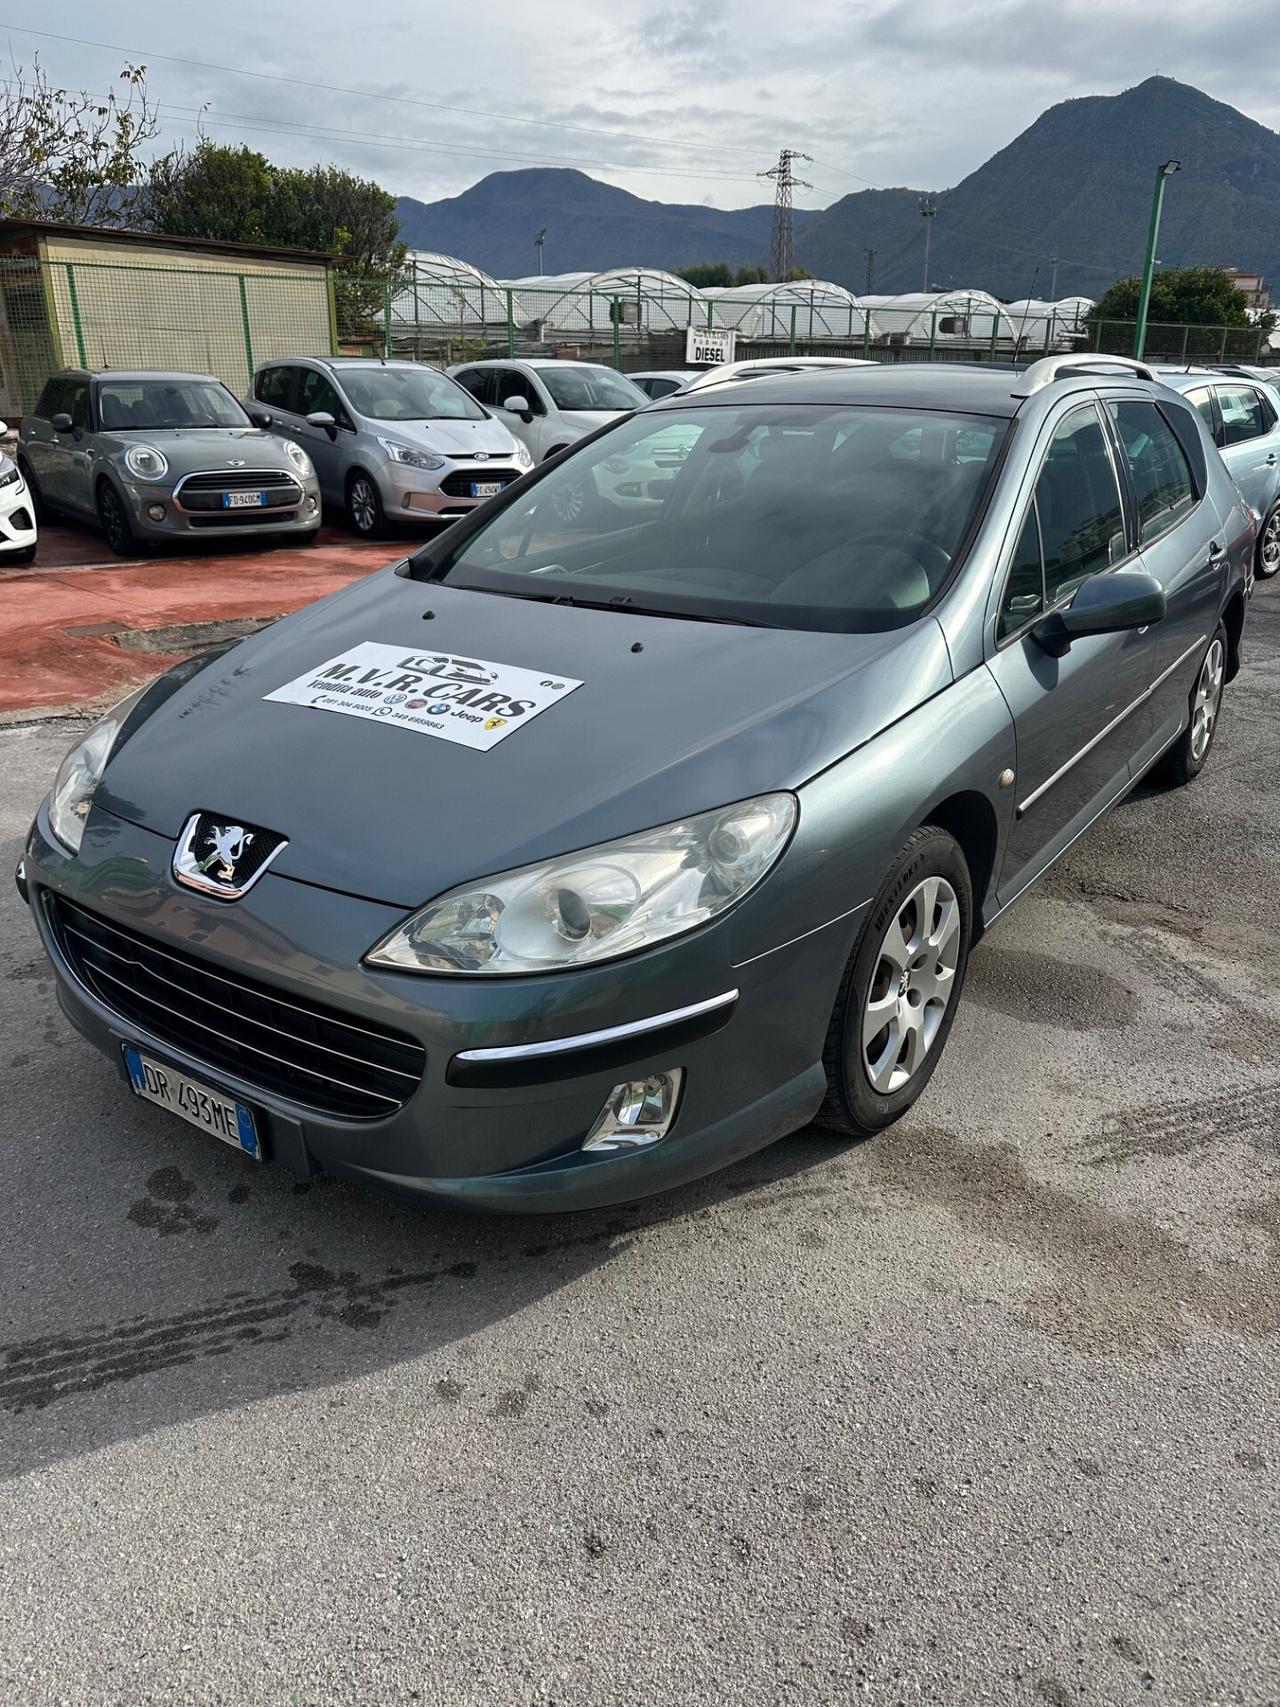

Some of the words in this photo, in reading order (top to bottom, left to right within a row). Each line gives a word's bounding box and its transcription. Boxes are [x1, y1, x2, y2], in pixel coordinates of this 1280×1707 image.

[695, 346, 725, 362] DIESEL
[307, 679, 353, 694] Vendita
[351, 687, 383, 699] auto
[450, 710, 484, 724] Jeep
[143, 1062, 171, 1102] DR
[178, 1080, 239, 1141] 493ME
